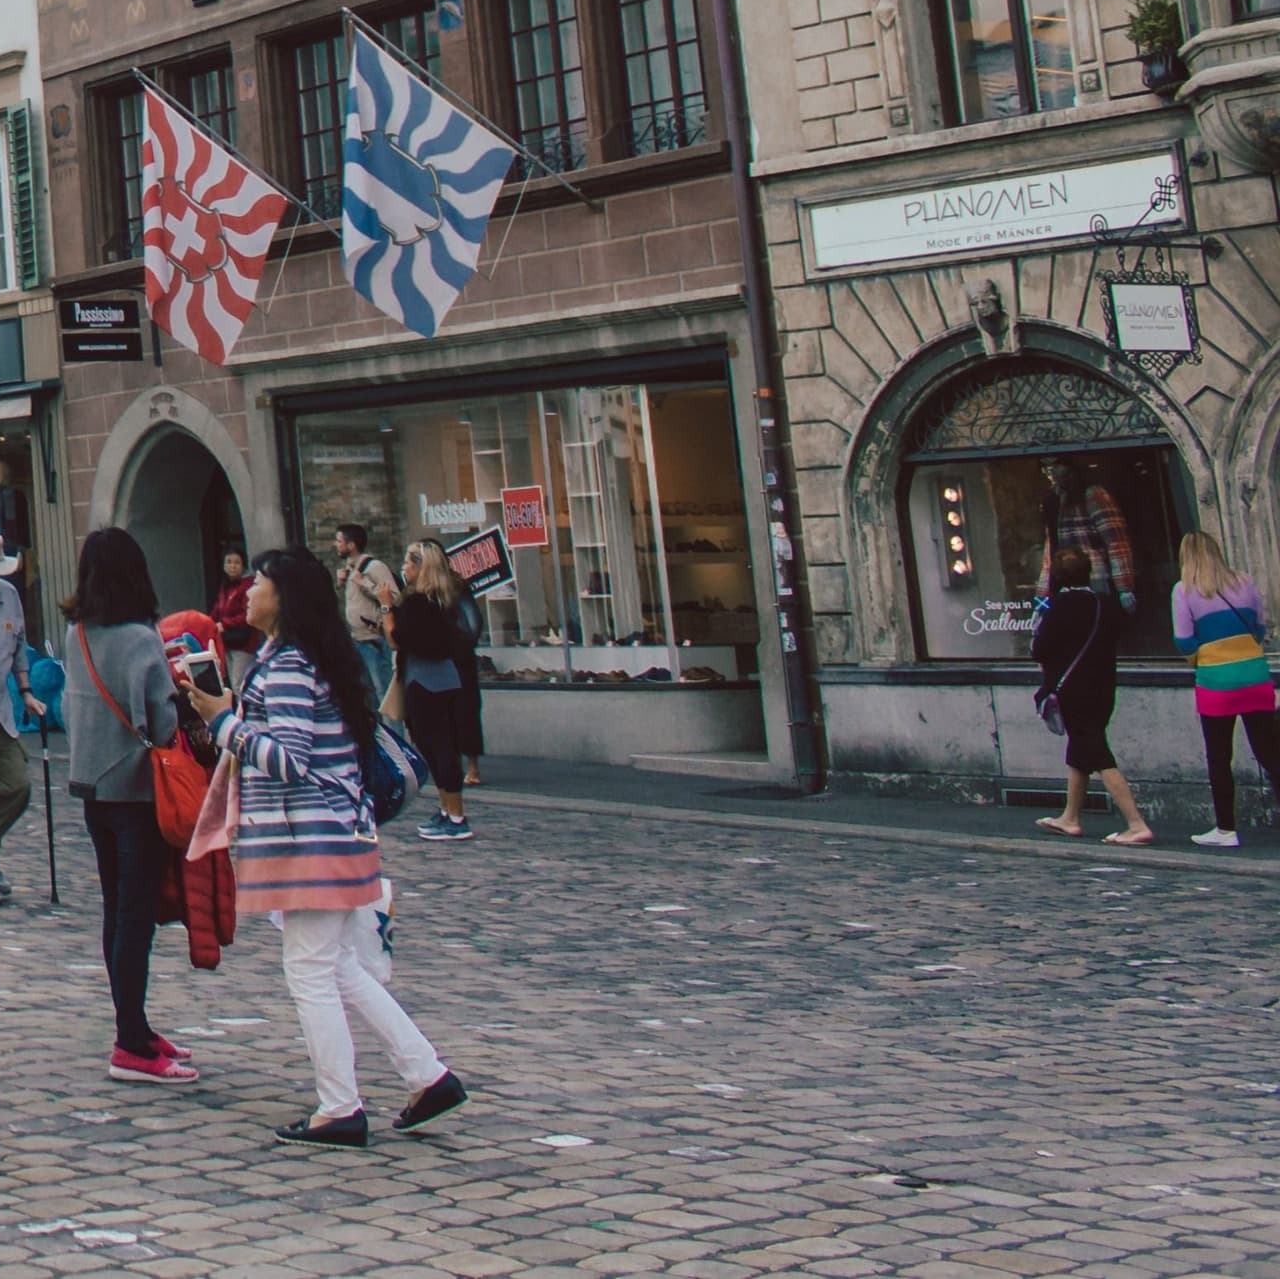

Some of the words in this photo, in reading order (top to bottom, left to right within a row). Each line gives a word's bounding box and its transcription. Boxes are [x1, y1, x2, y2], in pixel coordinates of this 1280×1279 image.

[985, 600, 1002, 610] See
[1003, 602, 1021, 611] you
[1023, 600, 1032, 609] in
[963, 608, 1042, 635] Scotland
